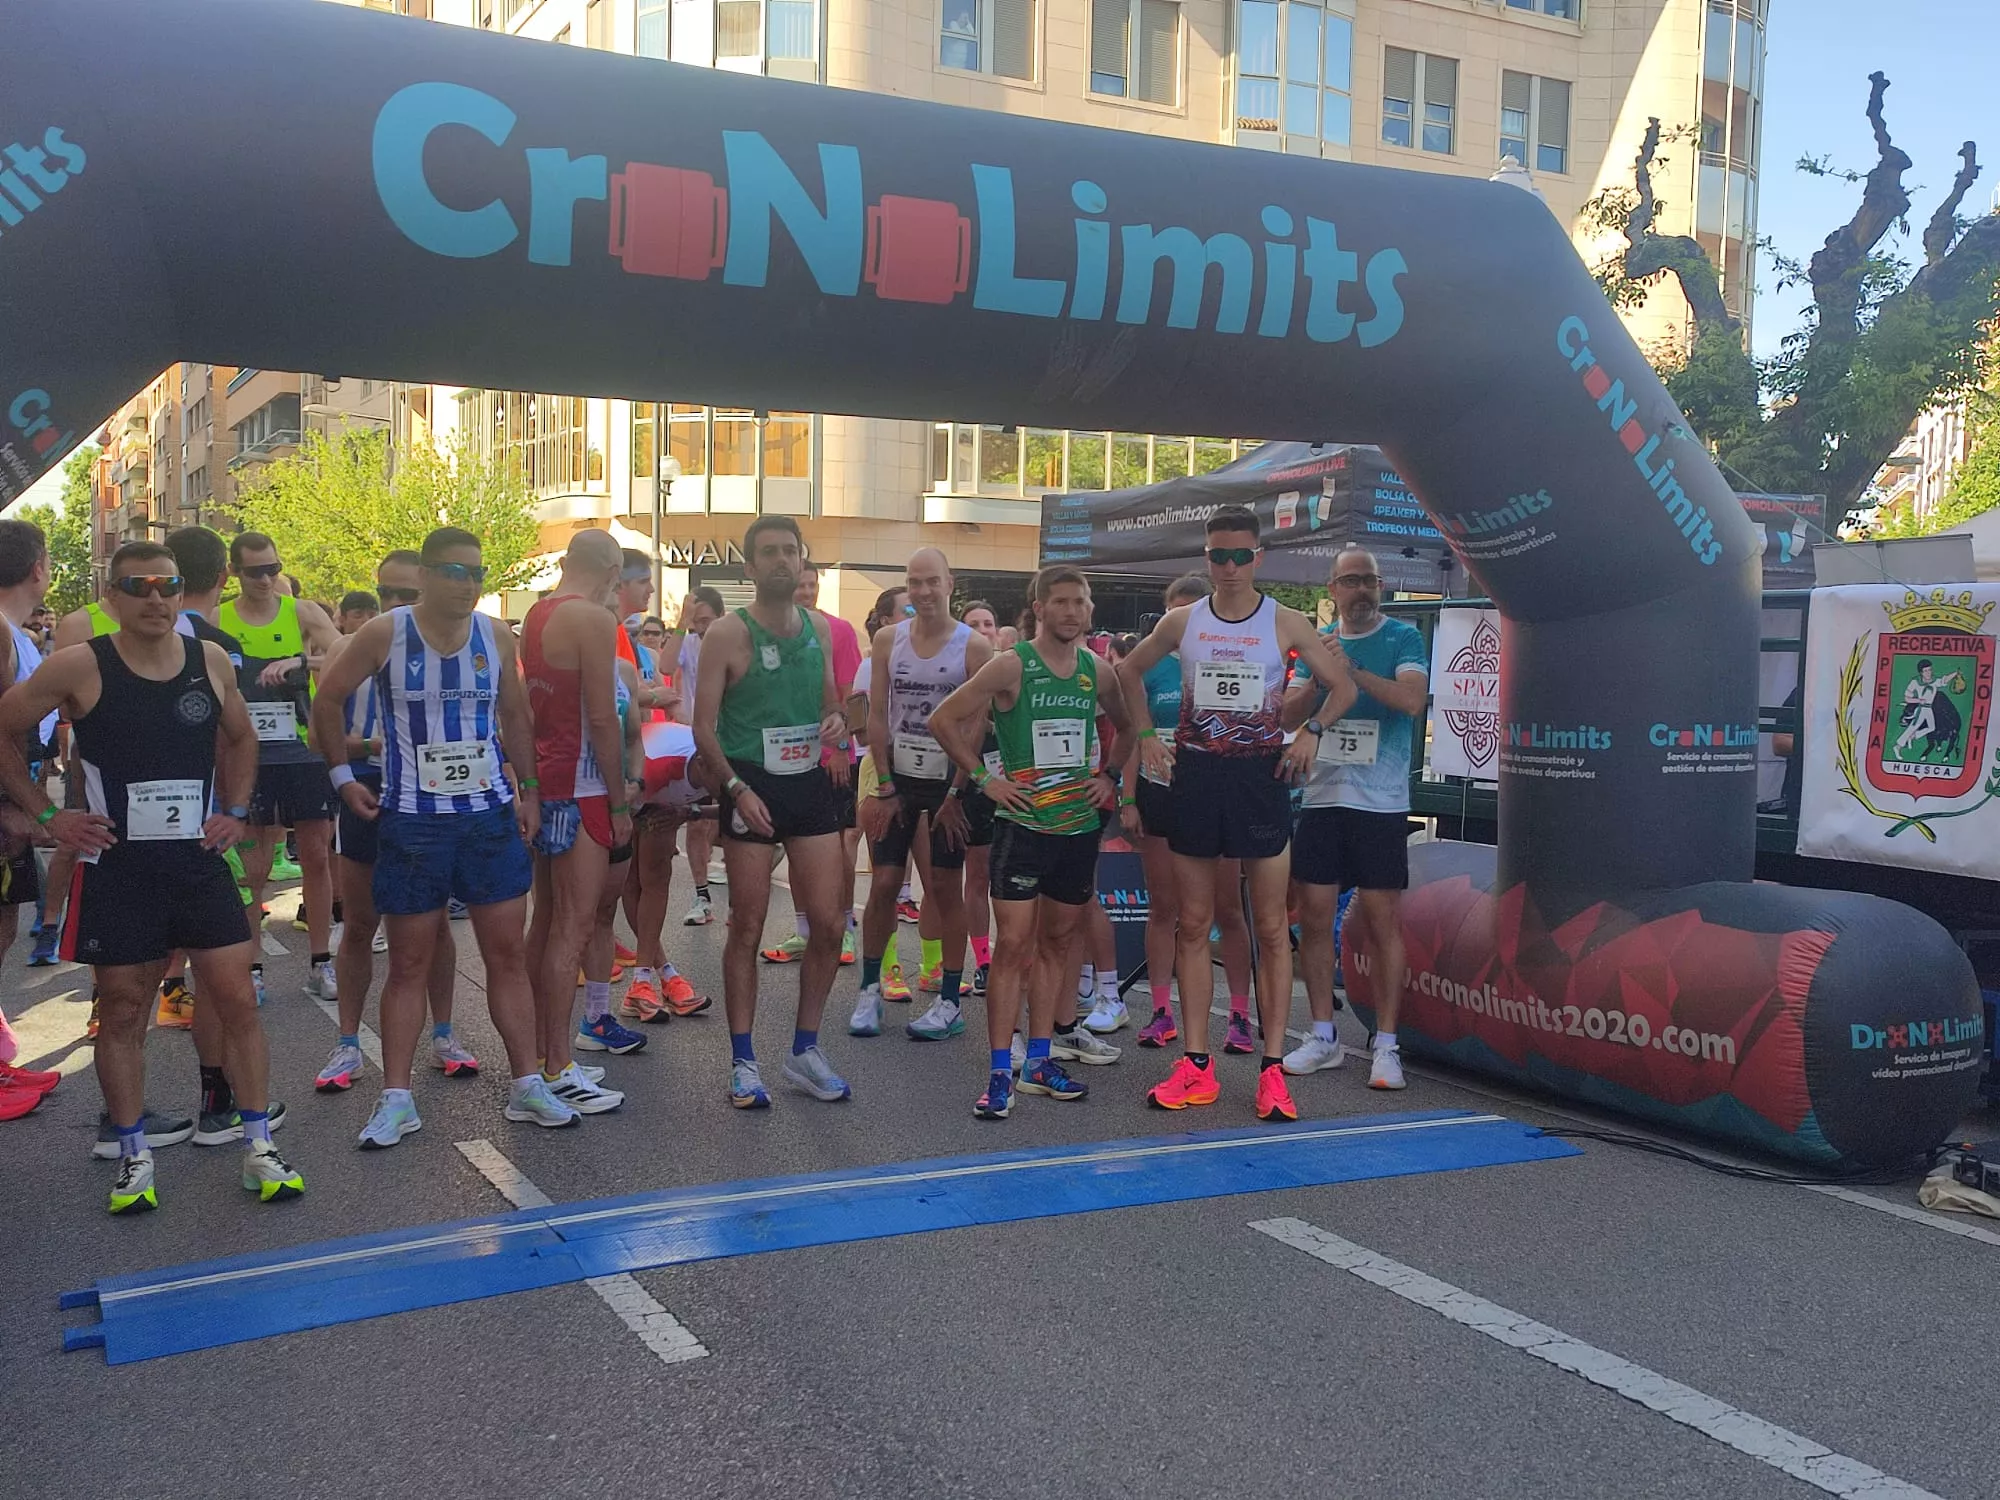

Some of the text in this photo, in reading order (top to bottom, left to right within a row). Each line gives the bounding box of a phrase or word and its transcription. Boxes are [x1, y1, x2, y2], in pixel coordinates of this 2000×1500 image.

[1375, 488, 1405, 503] BOLSA
[1373, 505, 1425, 520] SPEAKER Y
[1366, 520, 1408, 535] TROFEOS
[1408, 525, 1416, 536] Y
[1500, 531, 1558, 558] deportivos
[1888, 636, 1986, 653] RECREATIVA
[439, 690, 494, 700] GIPUZKOA
[1216, 681, 1241, 696] 86
[1452, 678, 1500, 697] SPAZ
[1031, 692, 1090, 710] Huesca
[1870, 656, 1890, 750] PEÑA
[1971, 663, 1992, 762] ZOITI
[257, 718, 277, 731] 24
[1062, 739, 1070, 753] 1
[1339, 737, 1358, 752] 73
[780, 744, 811, 761] 252
[1666, 751, 1700, 761] Servicio
[1701, 752, 1712, 761] de
[914, 754, 924, 767] 3
[1577, 757, 1585, 767] y
[444, 764, 470, 781] 29
[1544, 767, 1597, 779] deportivos
[1661, 763, 1695, 774] gestión
[1695, 763, 1706, 773] de
[1892, 763, 1951, 777] HUESCA
[166, 805, 181, 824] 2
[1353, 952, 1736, 1065] w.cronolimits2020.com
[1894, 1053, 1929, 1065] Servicio
[1929, 1051, 1940, 1062] de
[1871, 1067, 1900, 1079] vídeo
[1901, 1061, 1954, 1079] promocional
